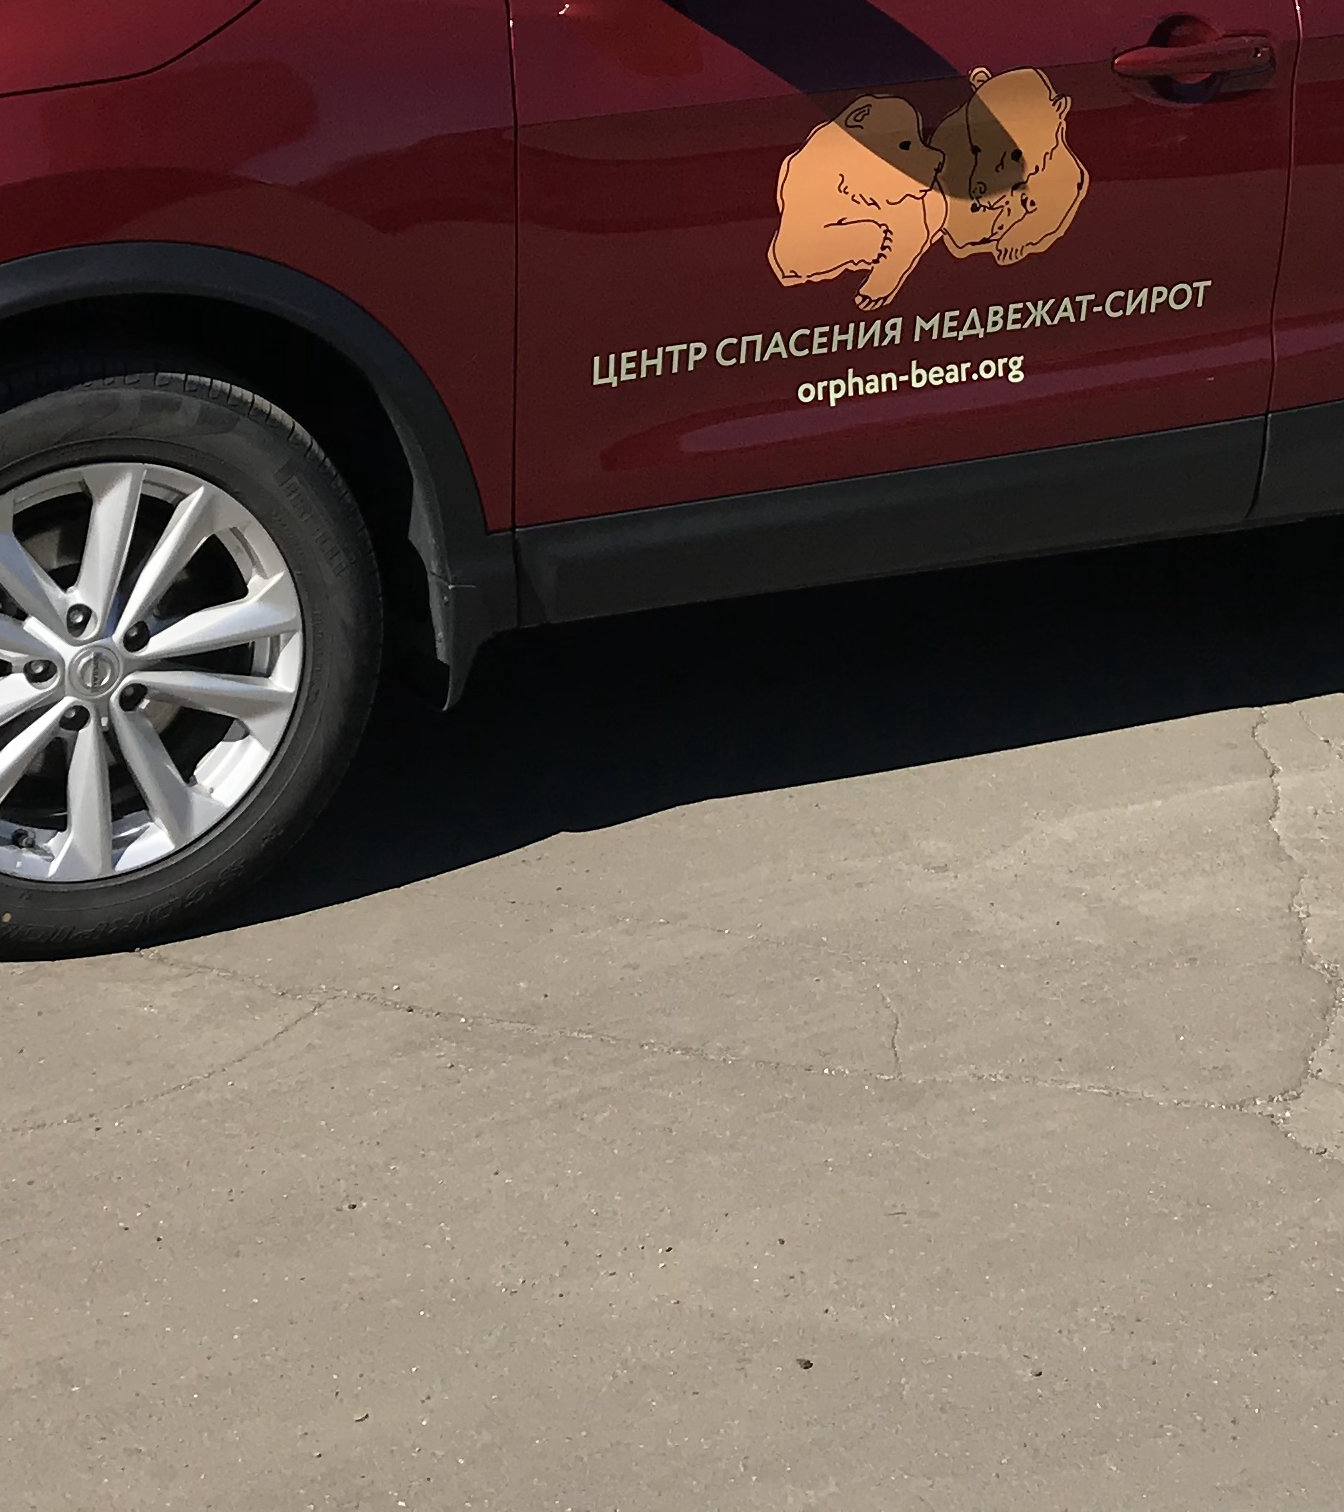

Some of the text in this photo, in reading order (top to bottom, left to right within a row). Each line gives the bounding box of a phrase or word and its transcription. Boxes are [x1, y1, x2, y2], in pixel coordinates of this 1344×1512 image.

[592, 280, 1213, 387] ЦЕНТР СПАСЕНИЯ МЕДВЕЖАТ-СИРОТ
[797, 354, 1025, 406] orphan-bear.org
